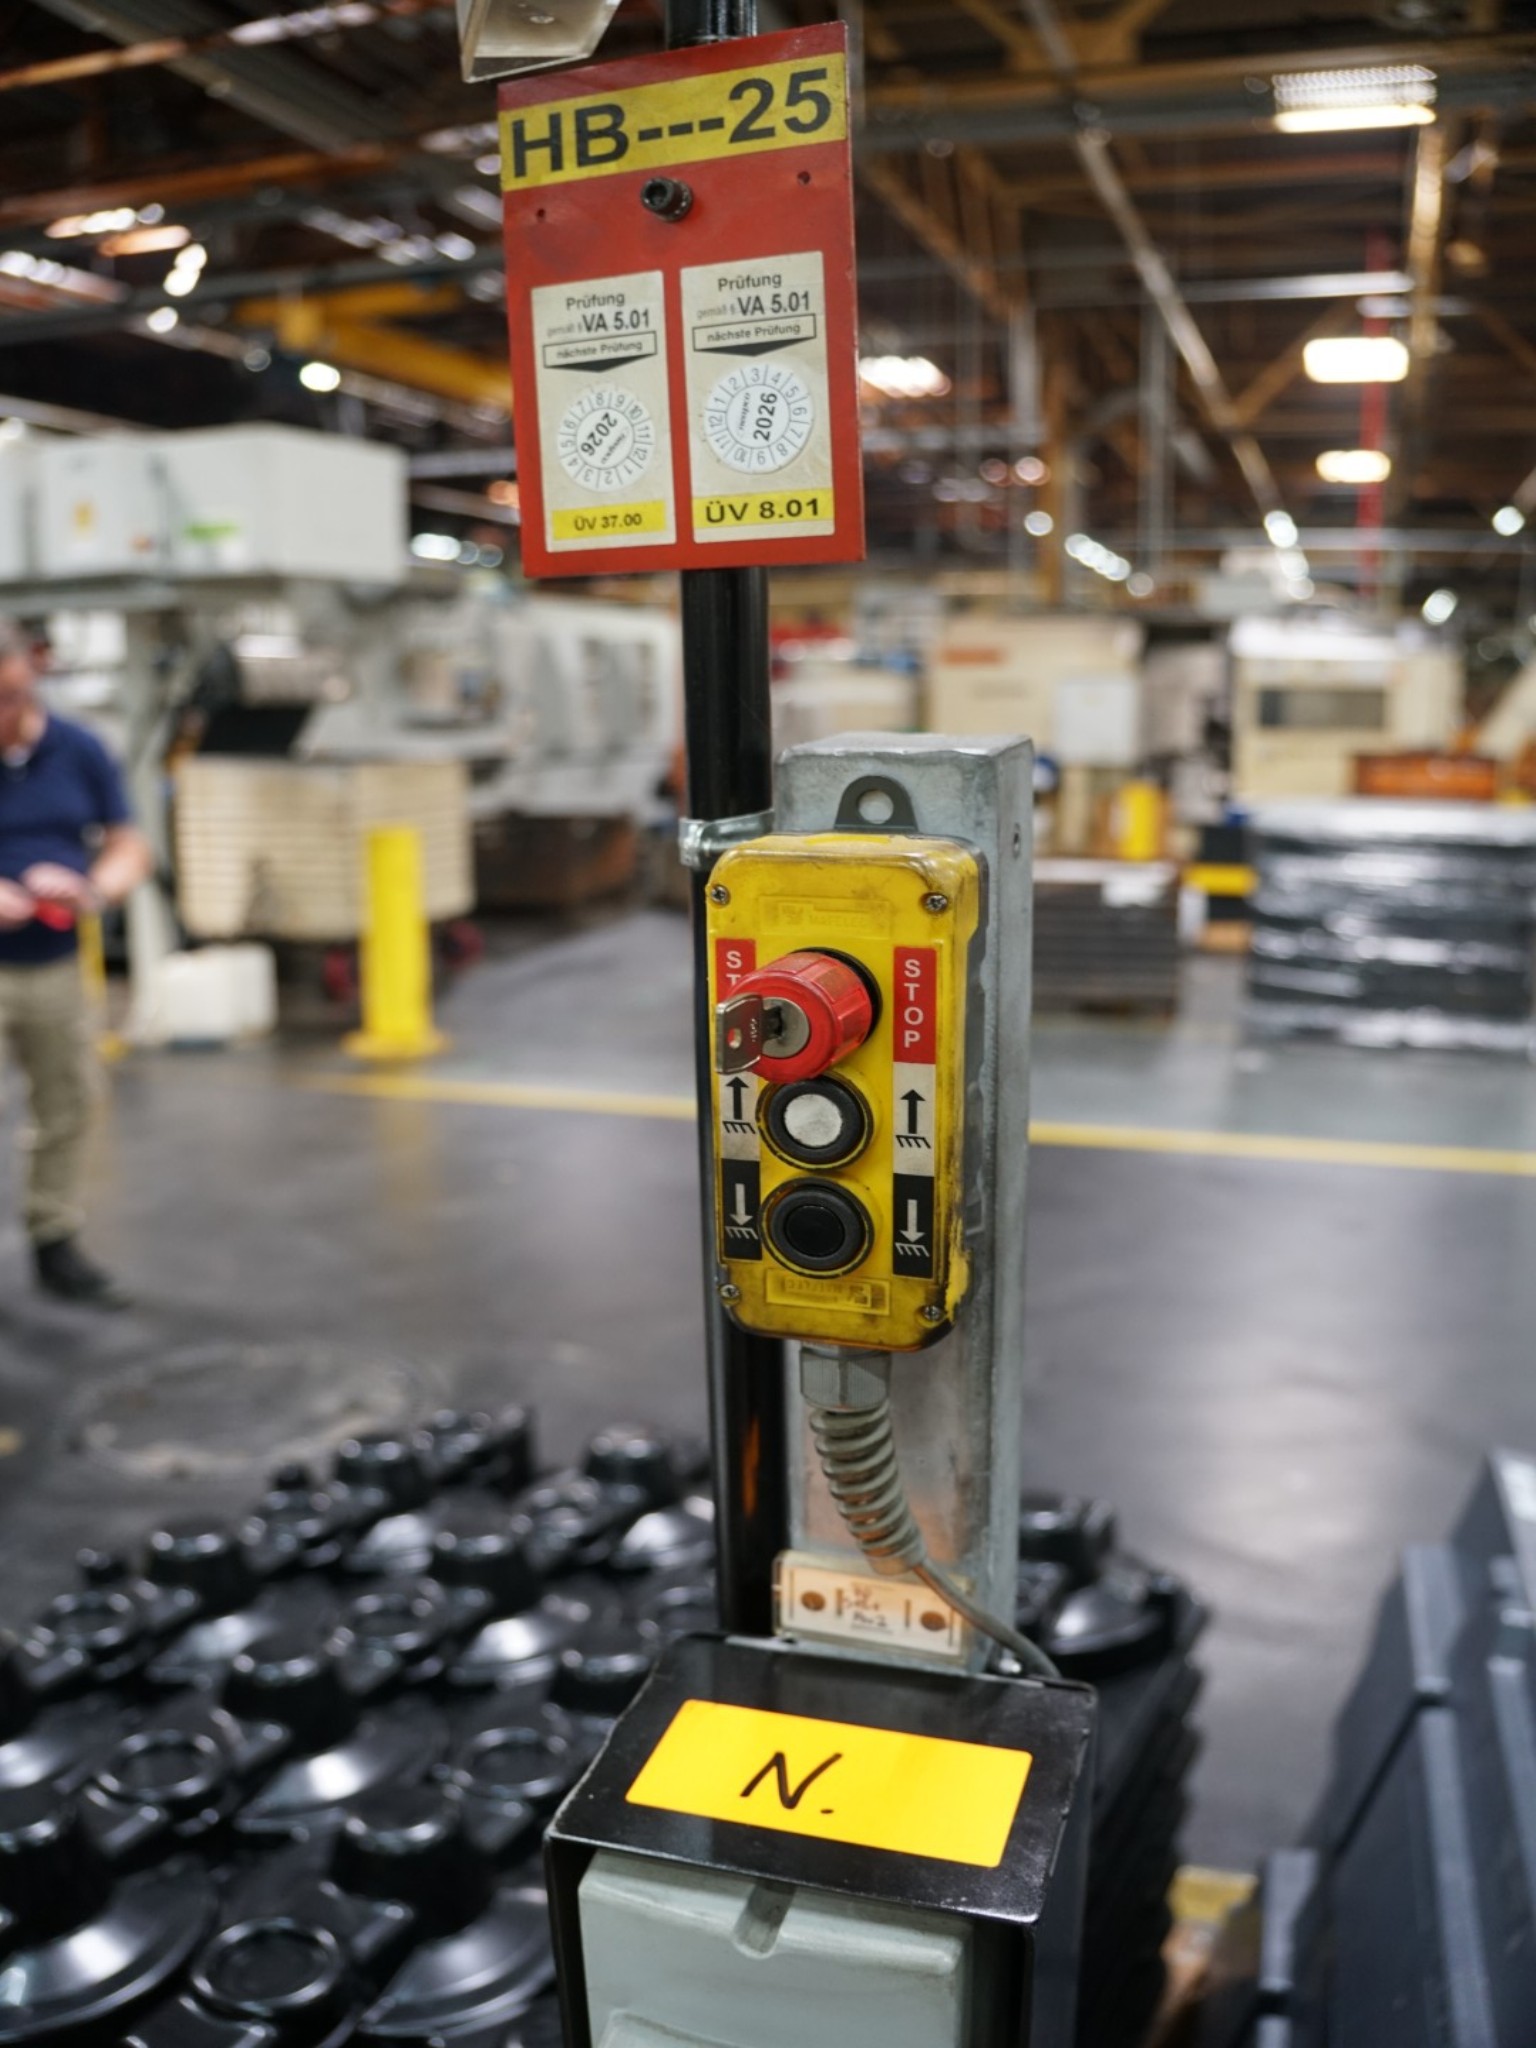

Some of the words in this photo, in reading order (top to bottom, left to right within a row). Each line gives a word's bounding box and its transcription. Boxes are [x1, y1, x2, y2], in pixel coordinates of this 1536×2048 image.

[512, 68, 832, 178] HB---25
[718, 274, 782, 292] Prüfung
[566, 293, 625, 310] Prüfung
[737, 295, 765, 316] VA
[771, 290, 810, 314] 5.01
[582, 312, 608, 332] VA
[613, 308, 649, 331] 5.01
[707, 329, 751, 343] nächste
[754, 323, 801, 337] Prüfung
[600, 341, 643, 355] Prüfung
[751, 368, 760, 382] 3
[771, 372, 782, 385] 4
[785, 385, 799, 399] 5
[753, 392, 778, 442] 2026
[581, 412, 618, 456] 2026
[574, 516, 597, 531] ÜV
[601, 513, 642, 529] 37.00
[706, 500, 748, 523] ÜV
[759, 498, 818, 519] 8.01
[904, 959, 924, 1048] STOP
